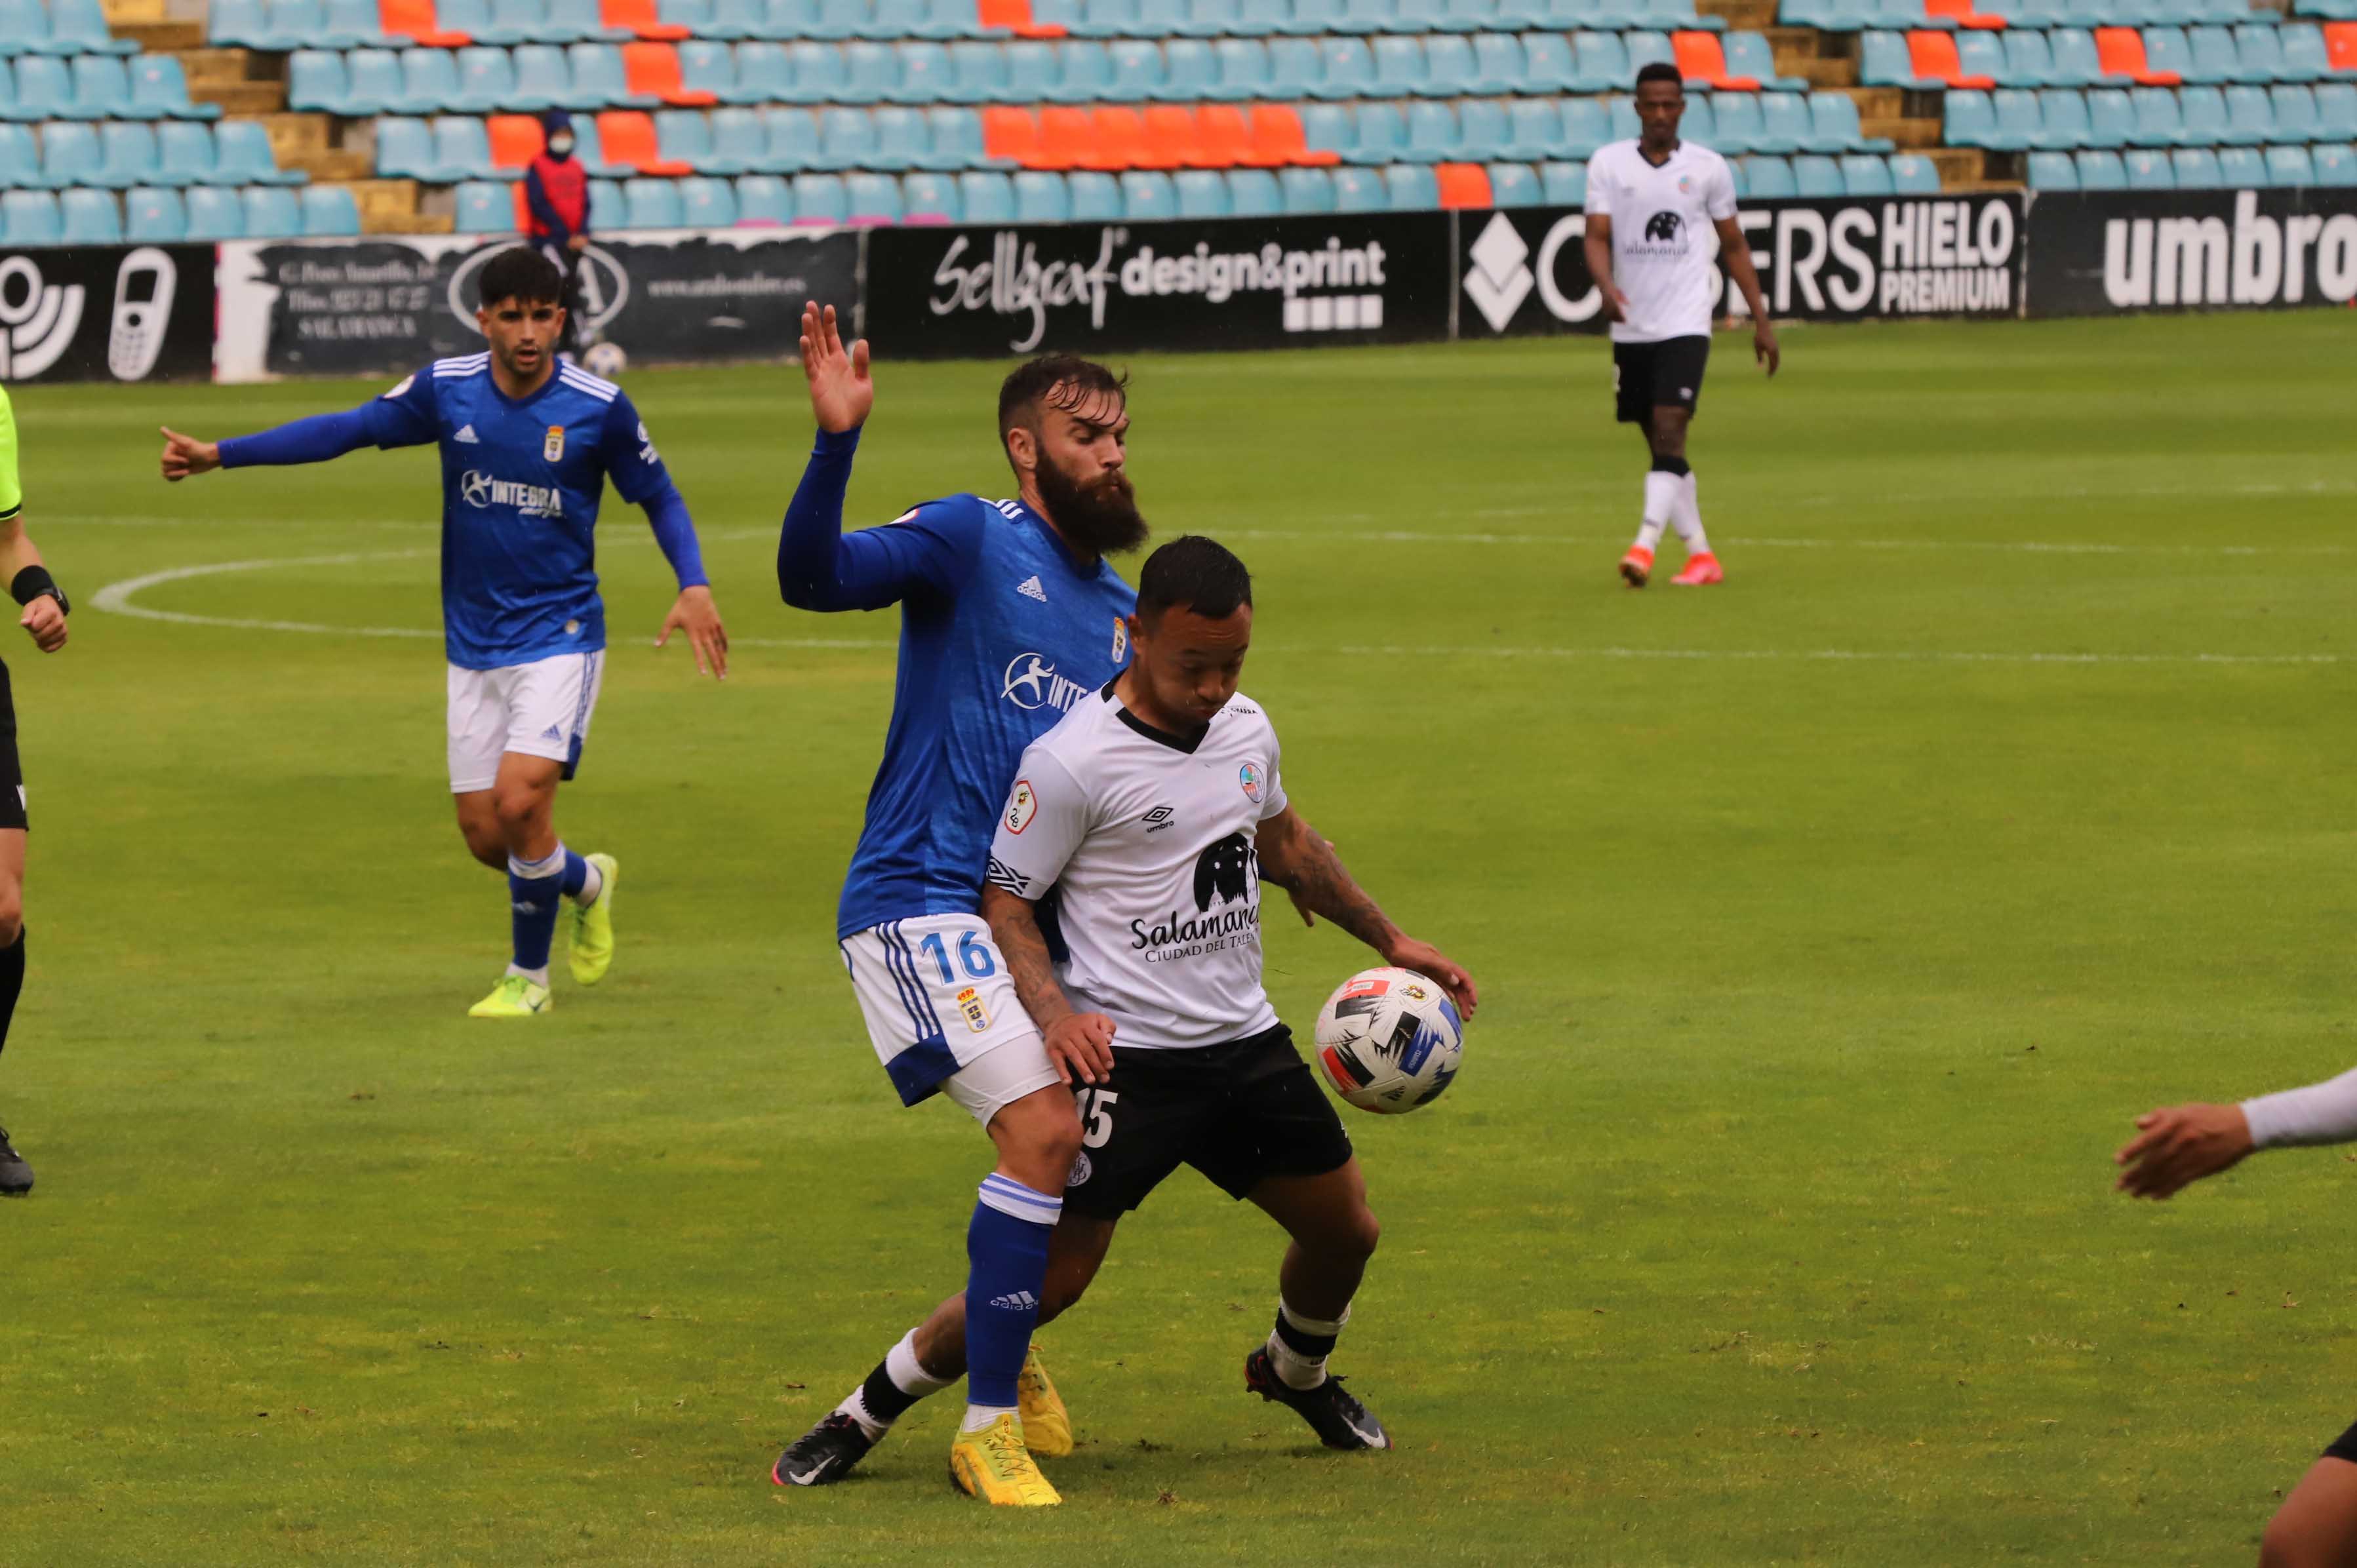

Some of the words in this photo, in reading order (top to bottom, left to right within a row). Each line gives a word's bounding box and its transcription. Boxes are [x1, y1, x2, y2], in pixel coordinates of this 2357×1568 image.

[1881, 199, 2014, 267] HIELO
[2103, 190, 2357, 306] umbro
[1536, 206, 1876, 323] CERS
[1880, 266, 2010, 313] PREMIUM
[1147, 820, 1174, 833] umbro
[918, 930, 997, 986] 16
[1145, 945, 1202, 963] CIUDAD
[1205, 940, 1225, 954] DEL
